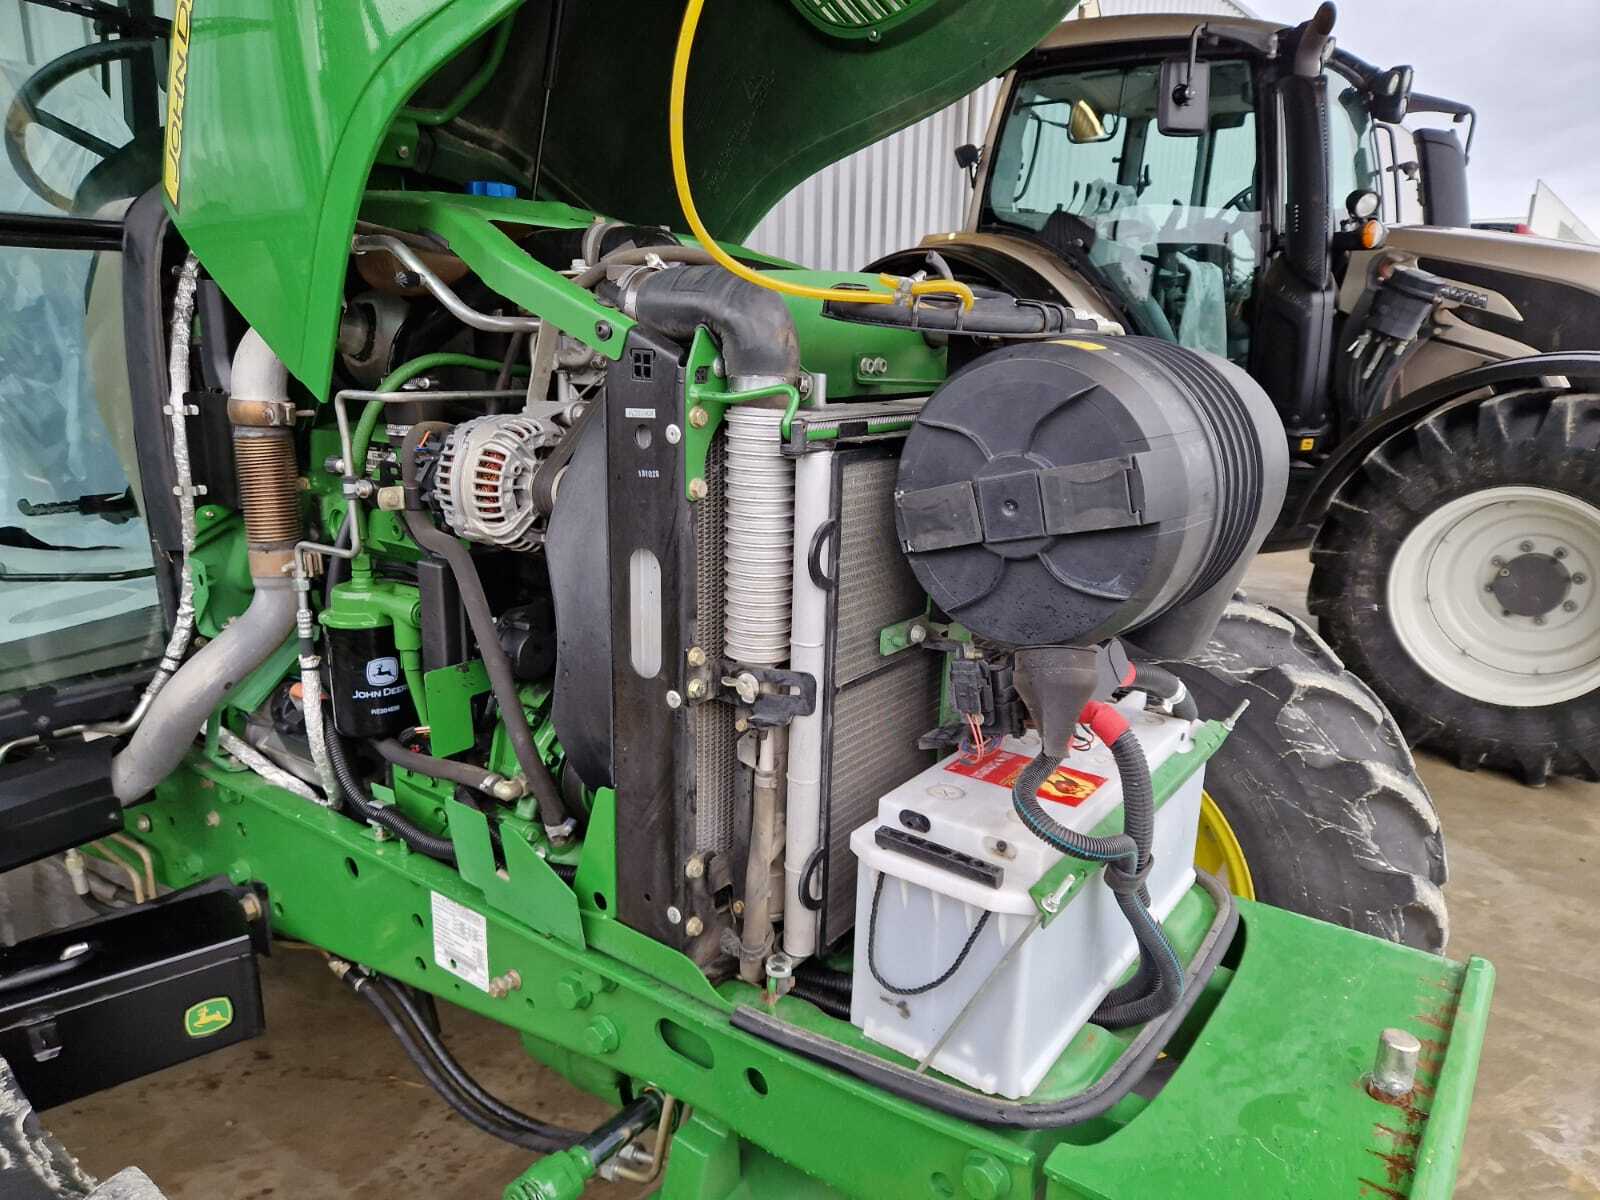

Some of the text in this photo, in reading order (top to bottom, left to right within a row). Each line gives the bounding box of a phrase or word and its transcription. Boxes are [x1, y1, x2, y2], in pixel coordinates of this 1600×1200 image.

[169, 0, 193, 184] JOHN D
[352, 689, 382, 699] JOHN
